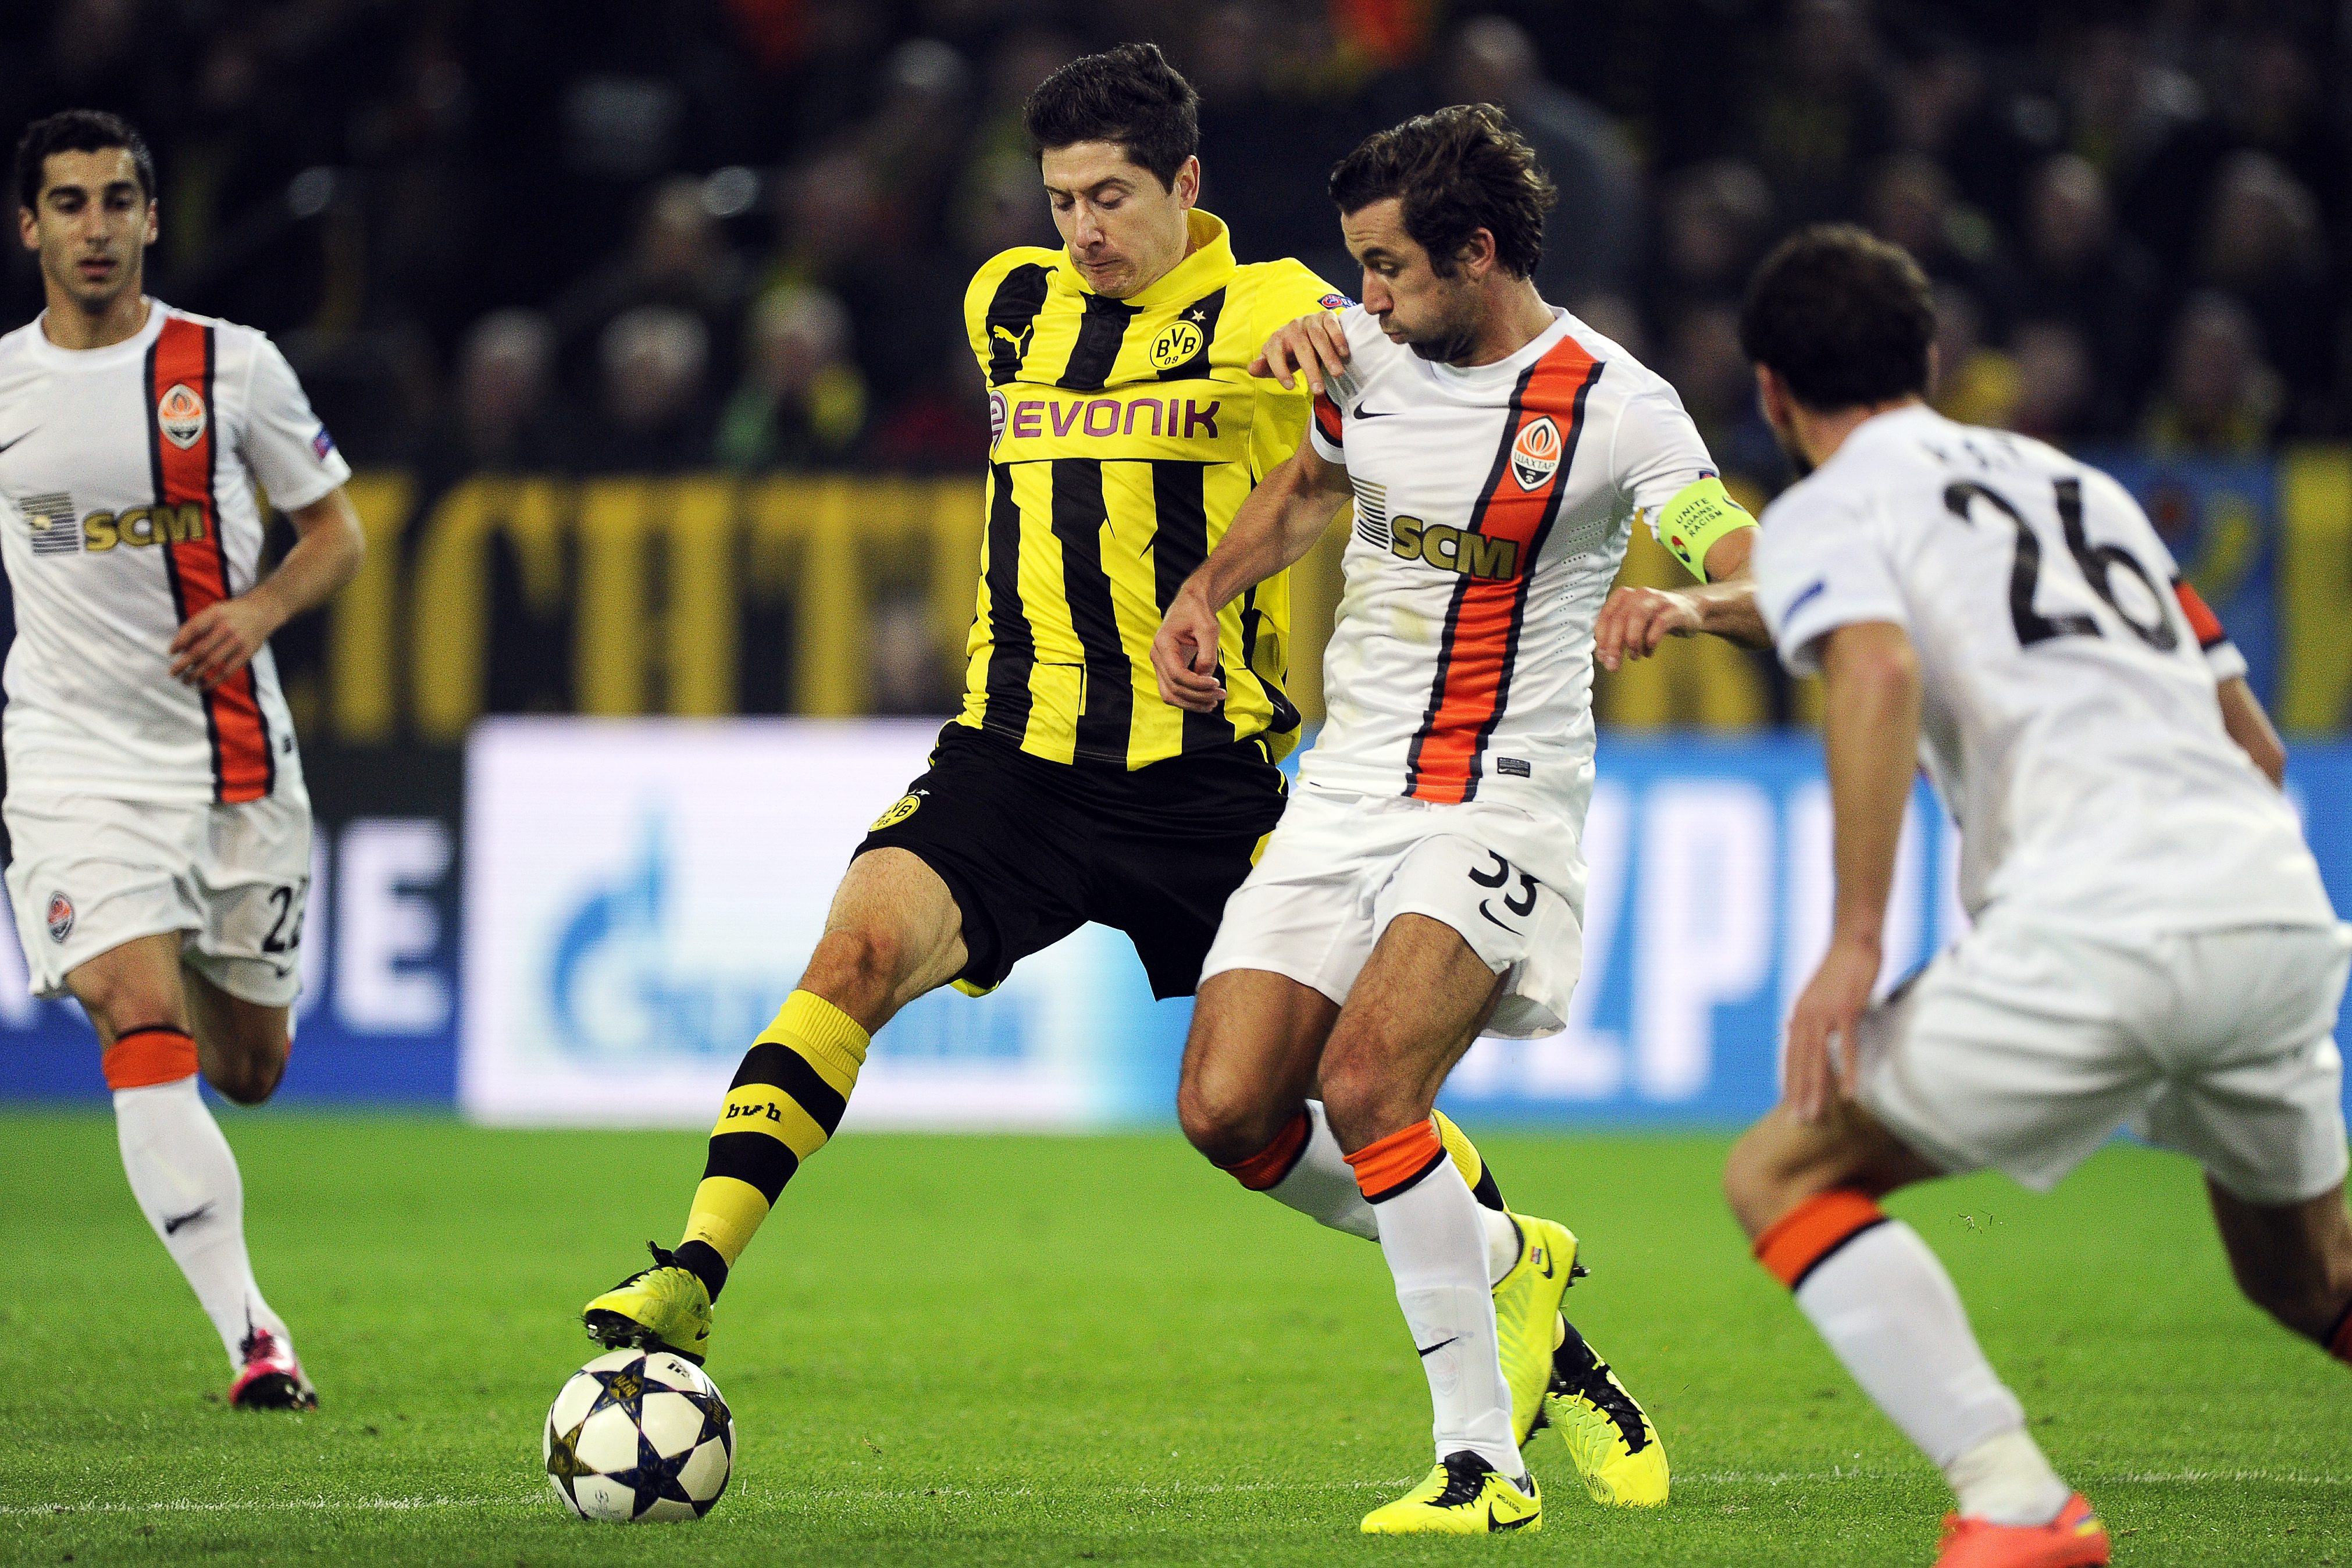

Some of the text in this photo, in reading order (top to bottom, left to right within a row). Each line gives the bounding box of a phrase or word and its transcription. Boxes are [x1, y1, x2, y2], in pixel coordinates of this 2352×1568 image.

[1156, 327, 1196, 358] BVB
[1164, 355, 1179, 365] 09
[1013, 398, 1220, 439] EVONIK
[1514, 451, 1555, 470] ШАХТАР
[1675, 498, 1710, 524] UNITE
[1683, 505, 1716, 530] AGAINST
[1688, 510, 1723, 537] RACISM
[83, 502, 205, 553] SCM
[1391, 515, 1519, 579] SCM
[1943, 474, 2180, 652] 26
